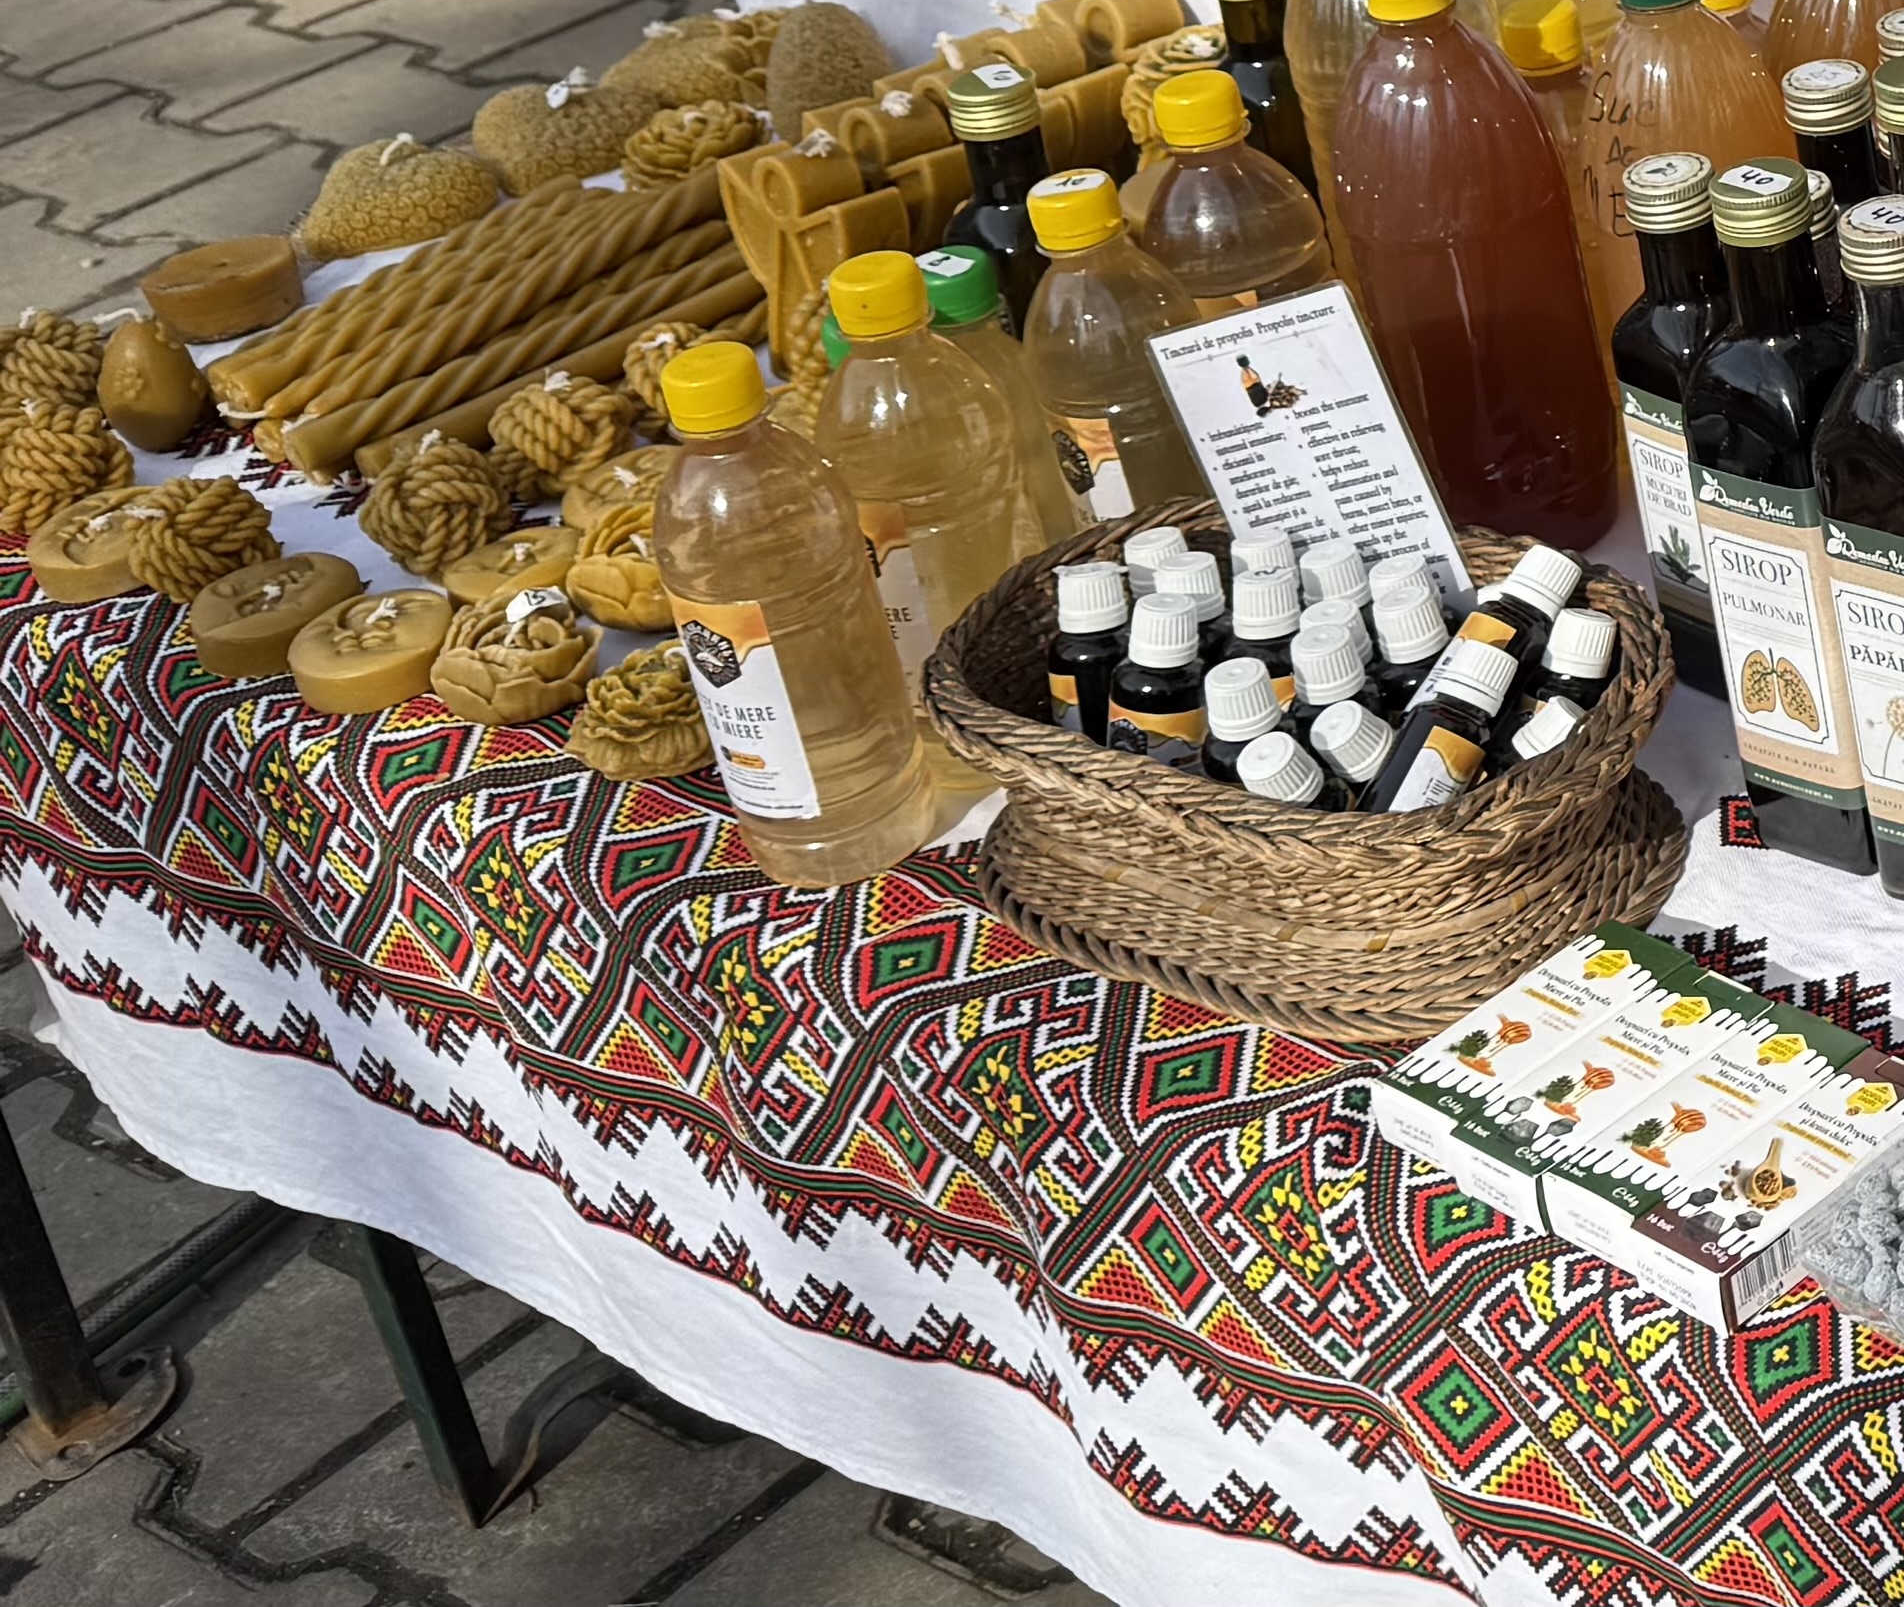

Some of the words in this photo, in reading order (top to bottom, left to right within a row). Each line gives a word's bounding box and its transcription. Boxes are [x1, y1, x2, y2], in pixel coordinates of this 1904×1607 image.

[1740, 168, 1773, 186] 40
[1722, 549, 1792, 586] SIROP
[1722, 591, 1807, 627] PULMONAR
